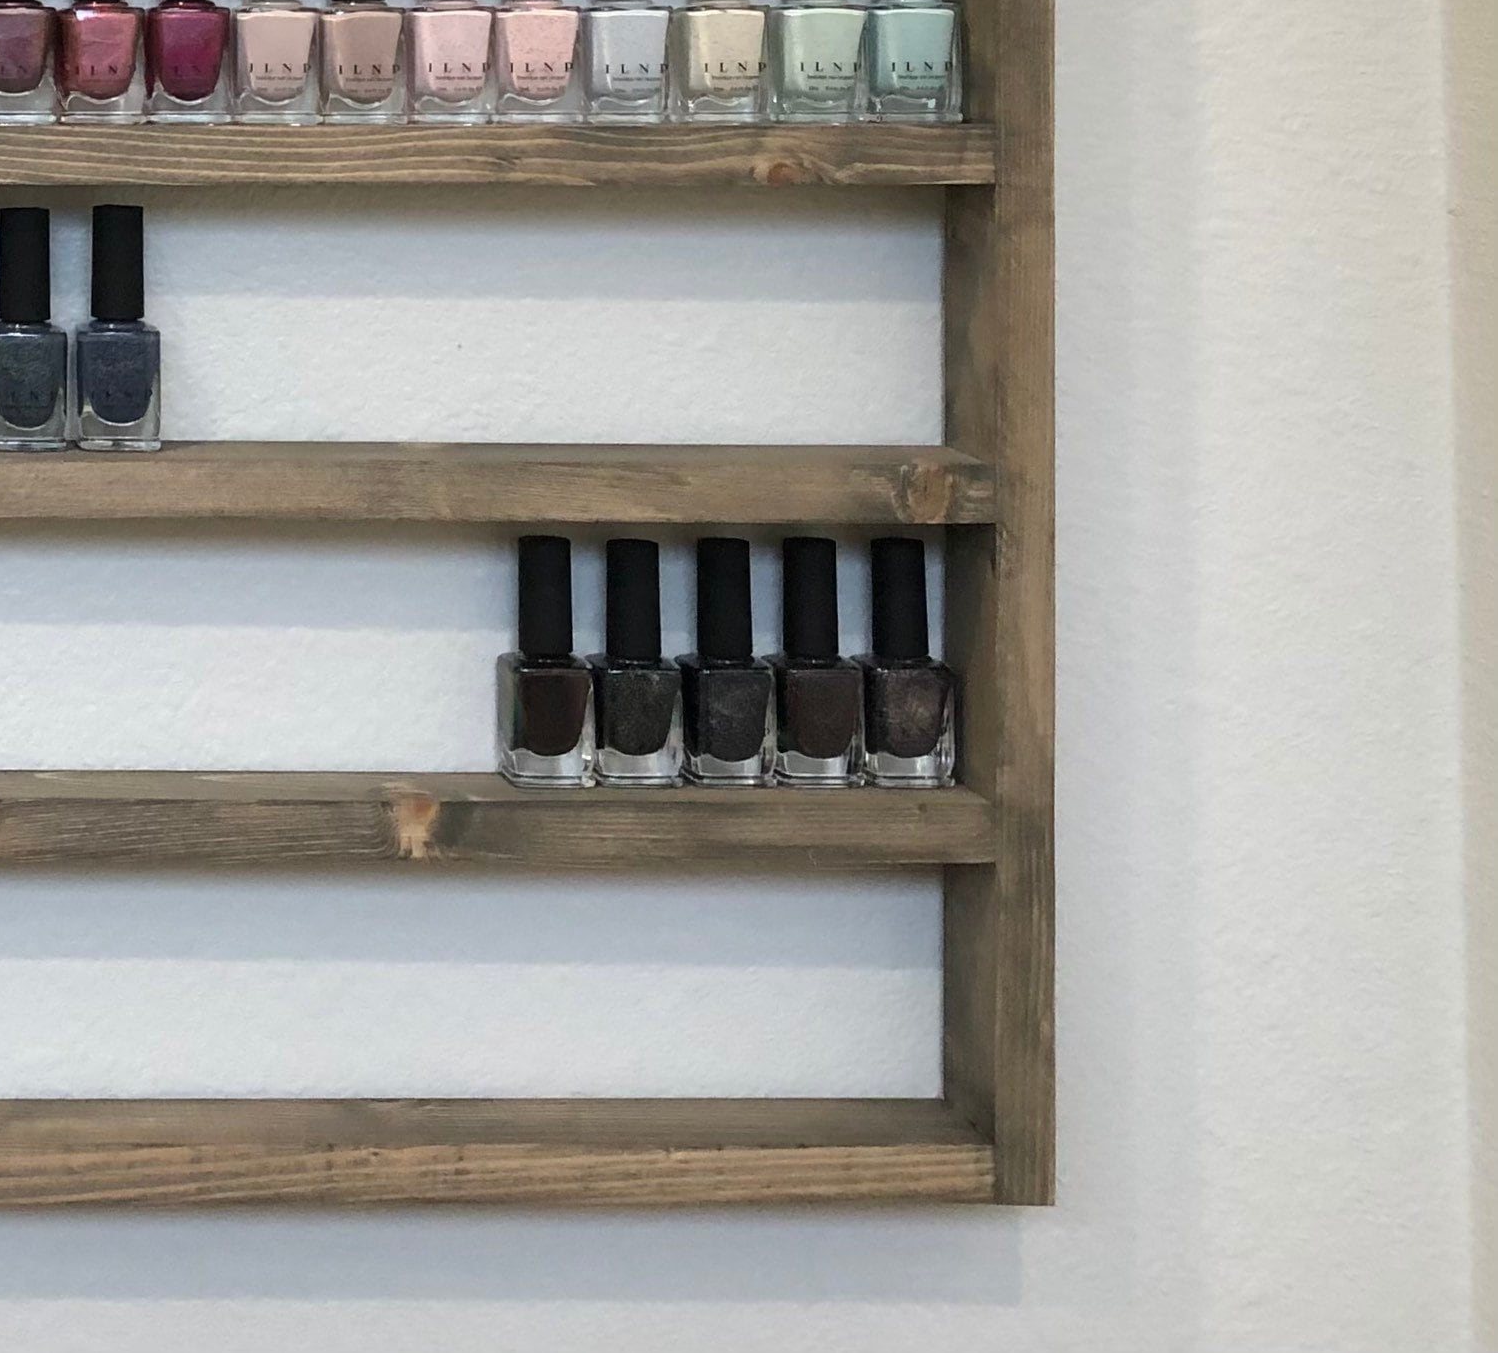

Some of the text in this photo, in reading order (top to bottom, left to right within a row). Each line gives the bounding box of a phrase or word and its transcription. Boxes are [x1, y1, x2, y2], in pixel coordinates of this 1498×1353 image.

[249, 62, 312, 74] ILNP
[338, 63, 401, 75] ILNP
[428, 62, 491, 73] ILNP
[510, 62, 574, 73] ILNP
[605, 62, 669, 74] ILNP
[704, 61, 767, 73] ILNP
[800, 61, 862, 72] ILNP
[891, 61, 953, 72] ILNP
